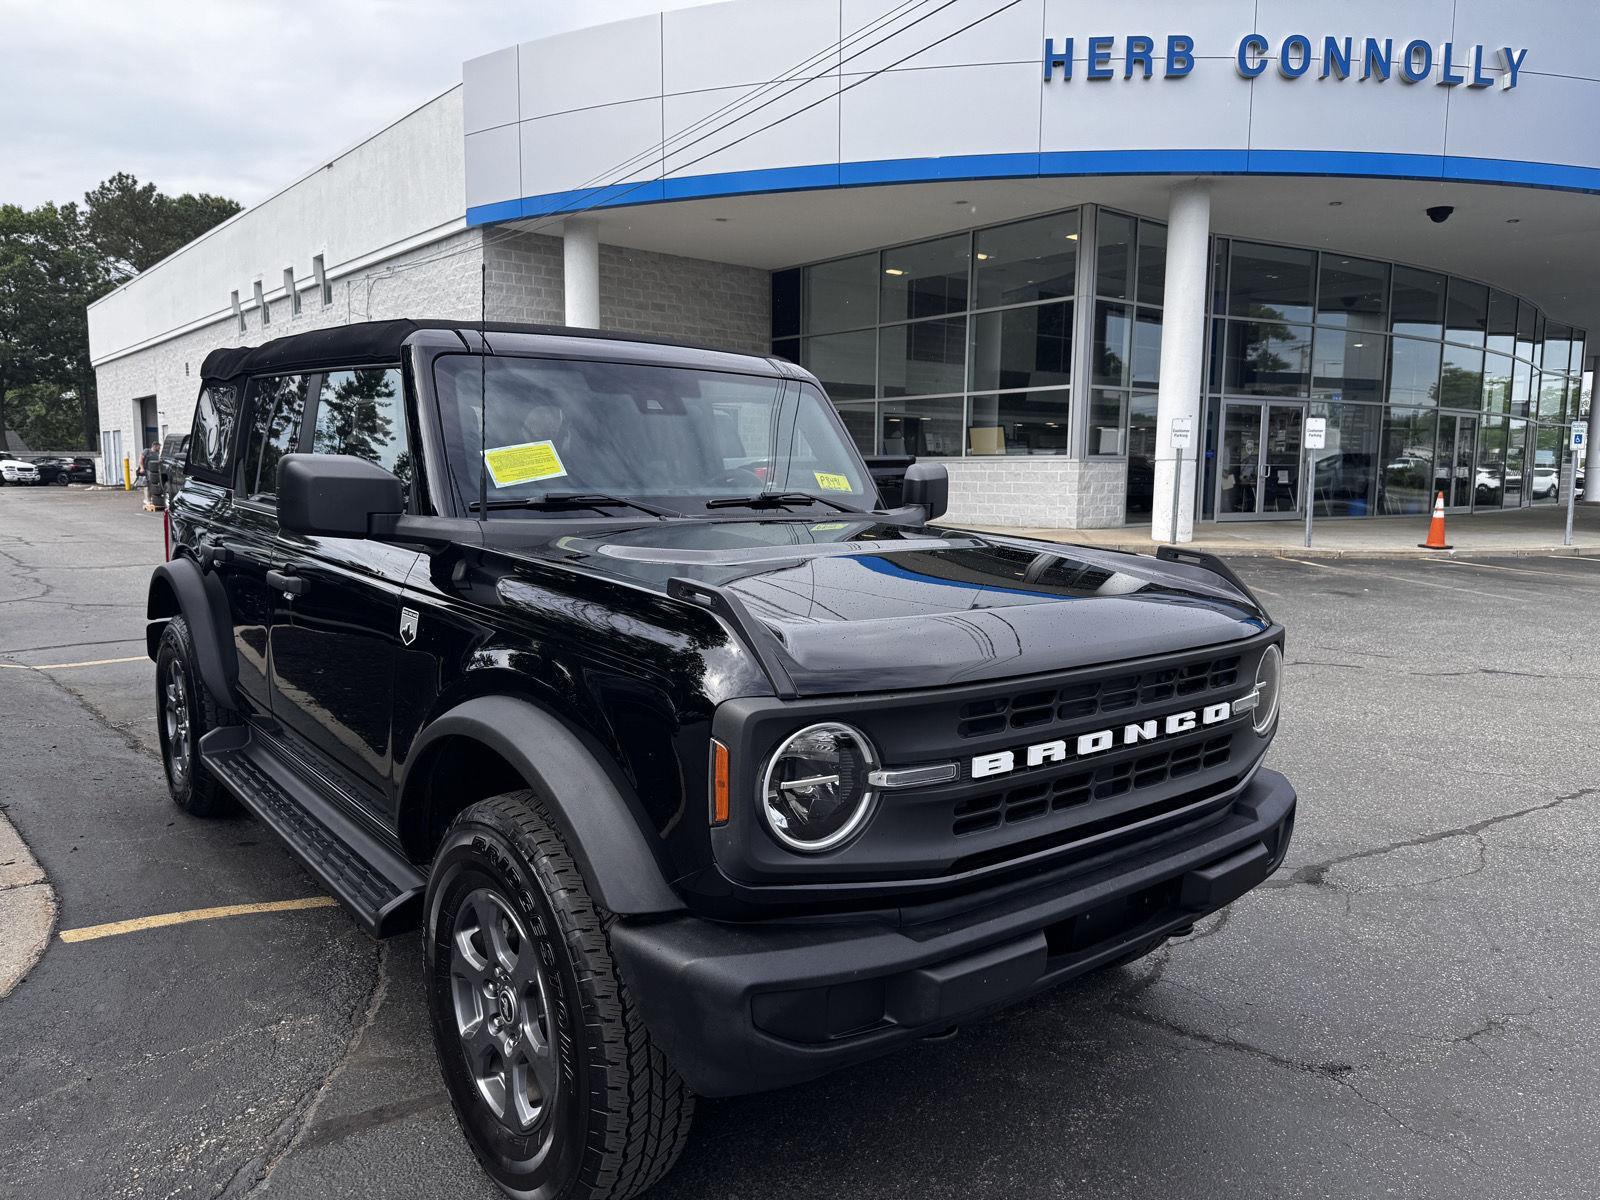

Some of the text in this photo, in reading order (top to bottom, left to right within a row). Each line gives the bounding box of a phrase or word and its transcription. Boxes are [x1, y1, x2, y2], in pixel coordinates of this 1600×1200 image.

[1044, 34, 1529, 90] HERB CONNOLLY
[971, 701, 1231, 779] BRONCO
